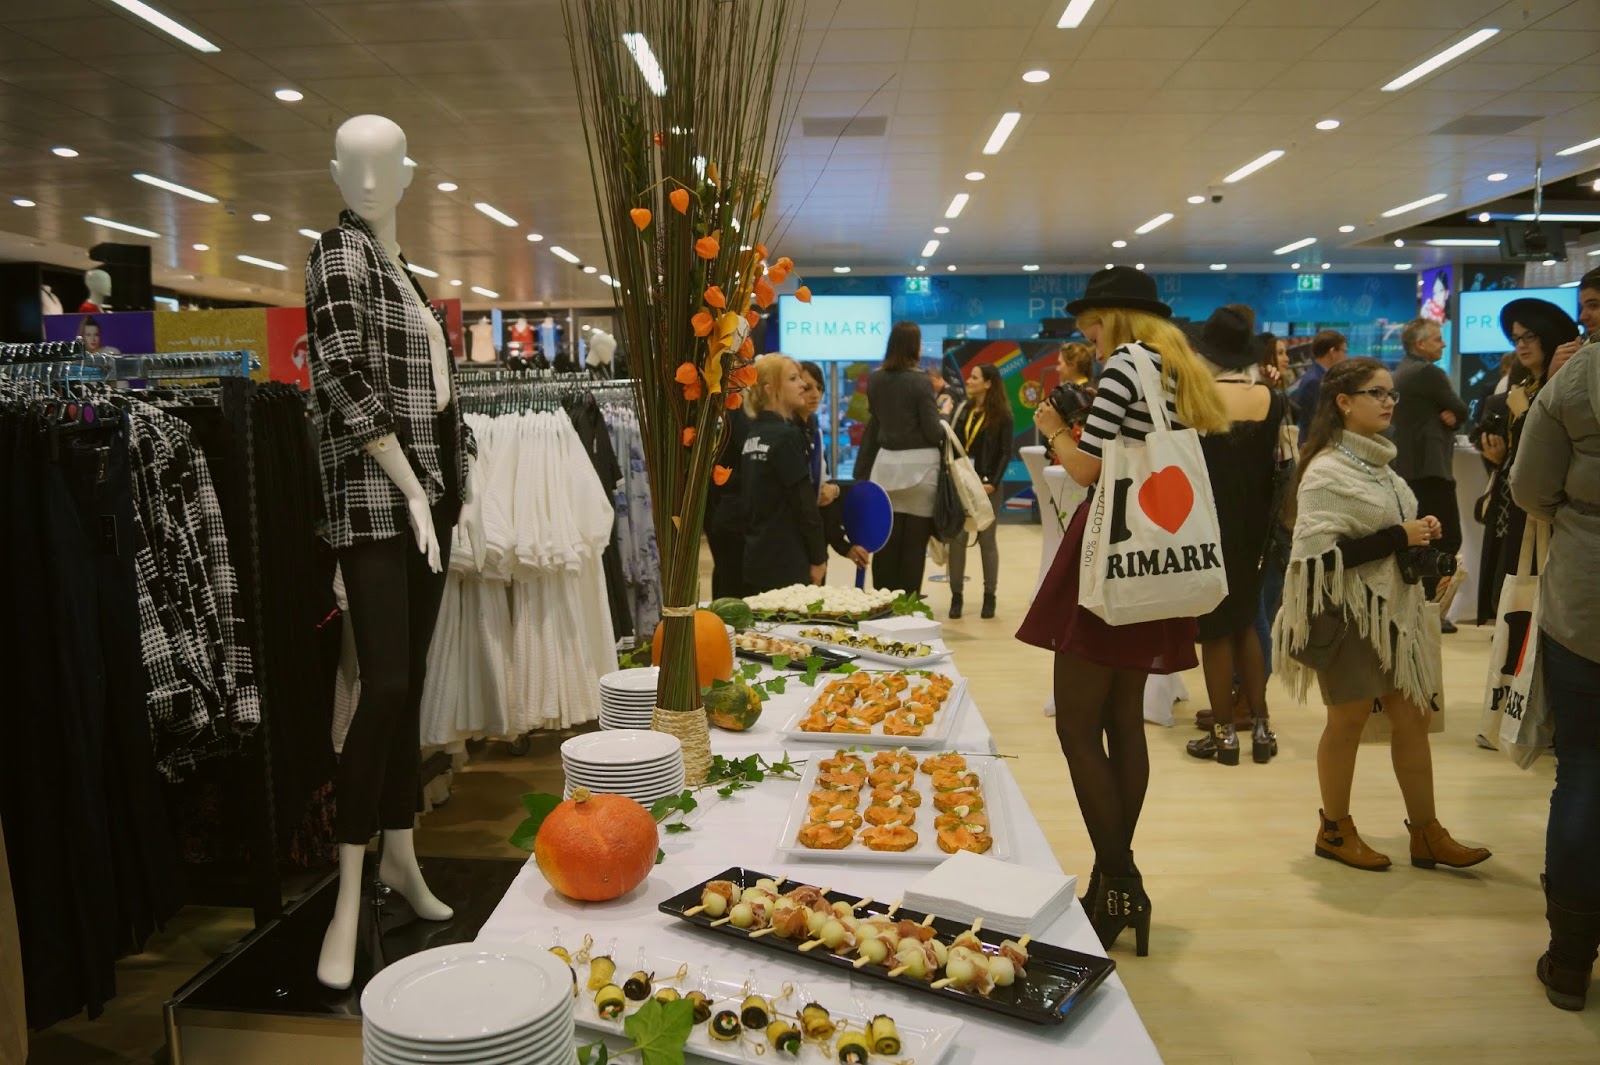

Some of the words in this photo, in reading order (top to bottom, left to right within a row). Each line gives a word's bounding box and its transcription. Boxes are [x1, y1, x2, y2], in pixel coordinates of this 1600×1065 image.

[786, 321, 882, 336] PRIMARK
[190, 336, 221, 347] WHAT
[225, 336, 232, 347] A
[1106, 542, 1222, 580] RIMARK
